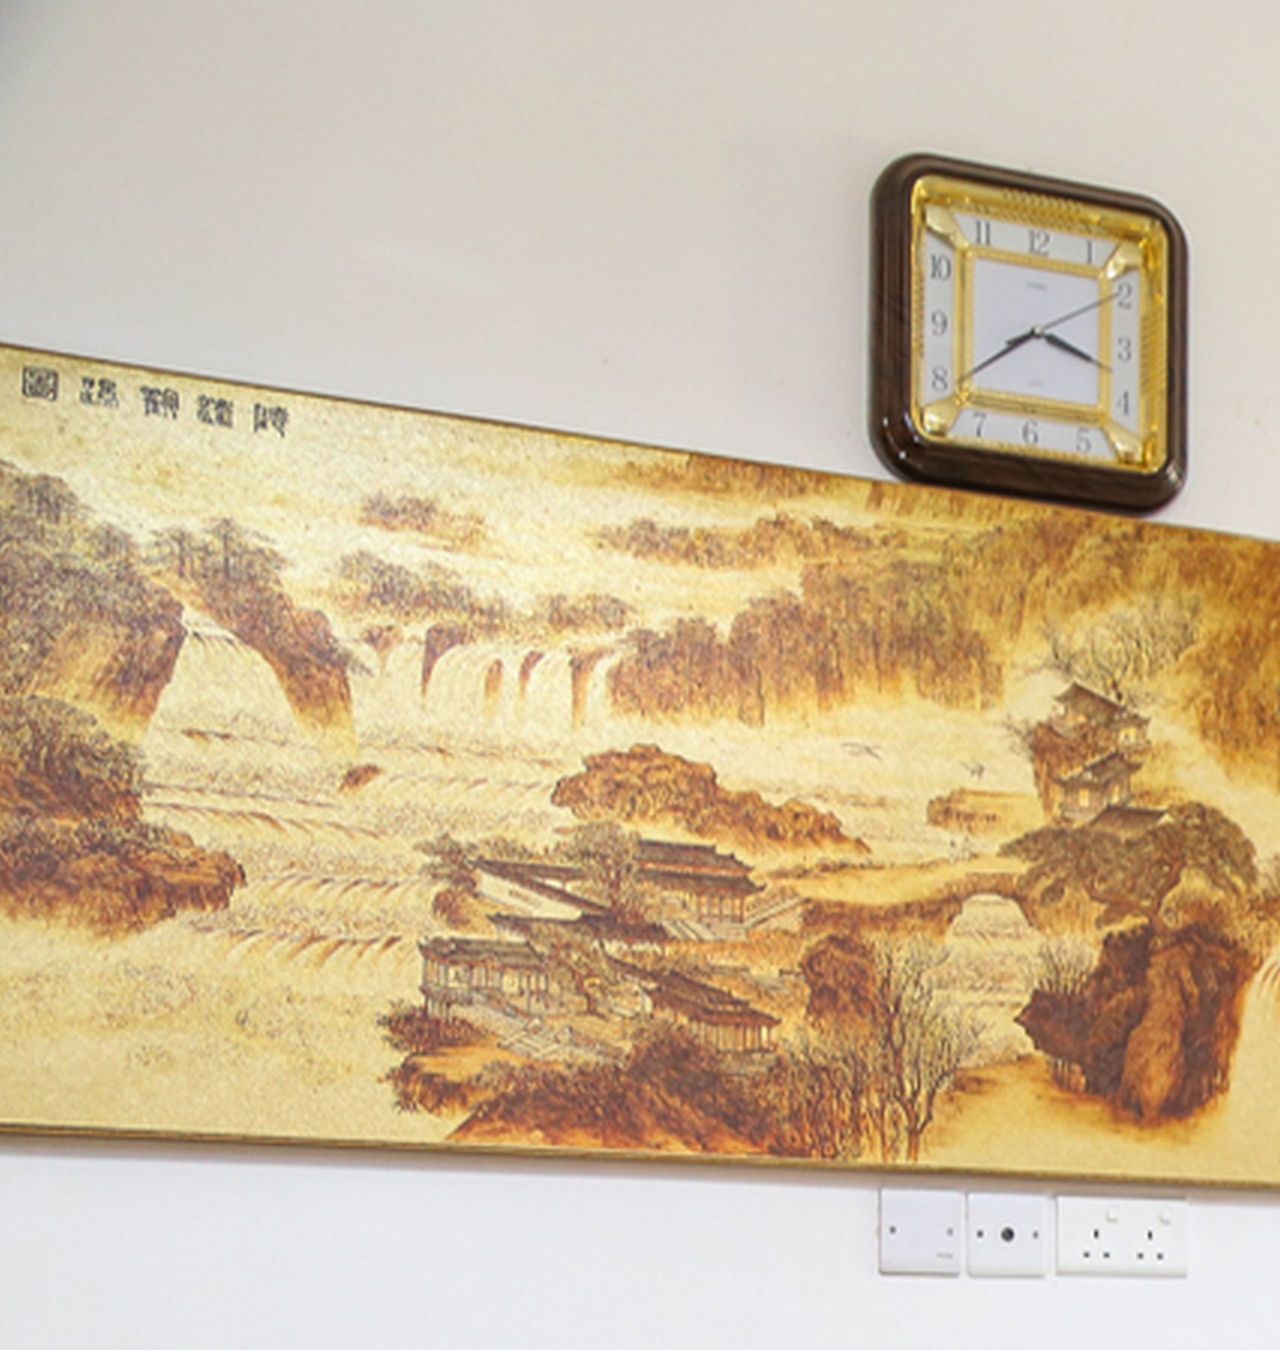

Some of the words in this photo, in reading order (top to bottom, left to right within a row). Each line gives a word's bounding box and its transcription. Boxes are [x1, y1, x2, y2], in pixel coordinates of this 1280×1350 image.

[976, 220, 991, 247] 11
[1028, 228, 1051, 257] 12
[1086, 240, 1093, 265] 1
[930, 254, 951, 281] 10
[1117, 282, 1133, 309] 2
[930, 311, 948, 337] 9
[1117, 337, 1132, 362] 3
[931, 369, 949, 393] 8
[1116, 391, 1131, 415] 4
[972, 412, 988, 438] 7
[1021, 420, 1039, 445] 6
[1075, 428, 1092, 454] 5
